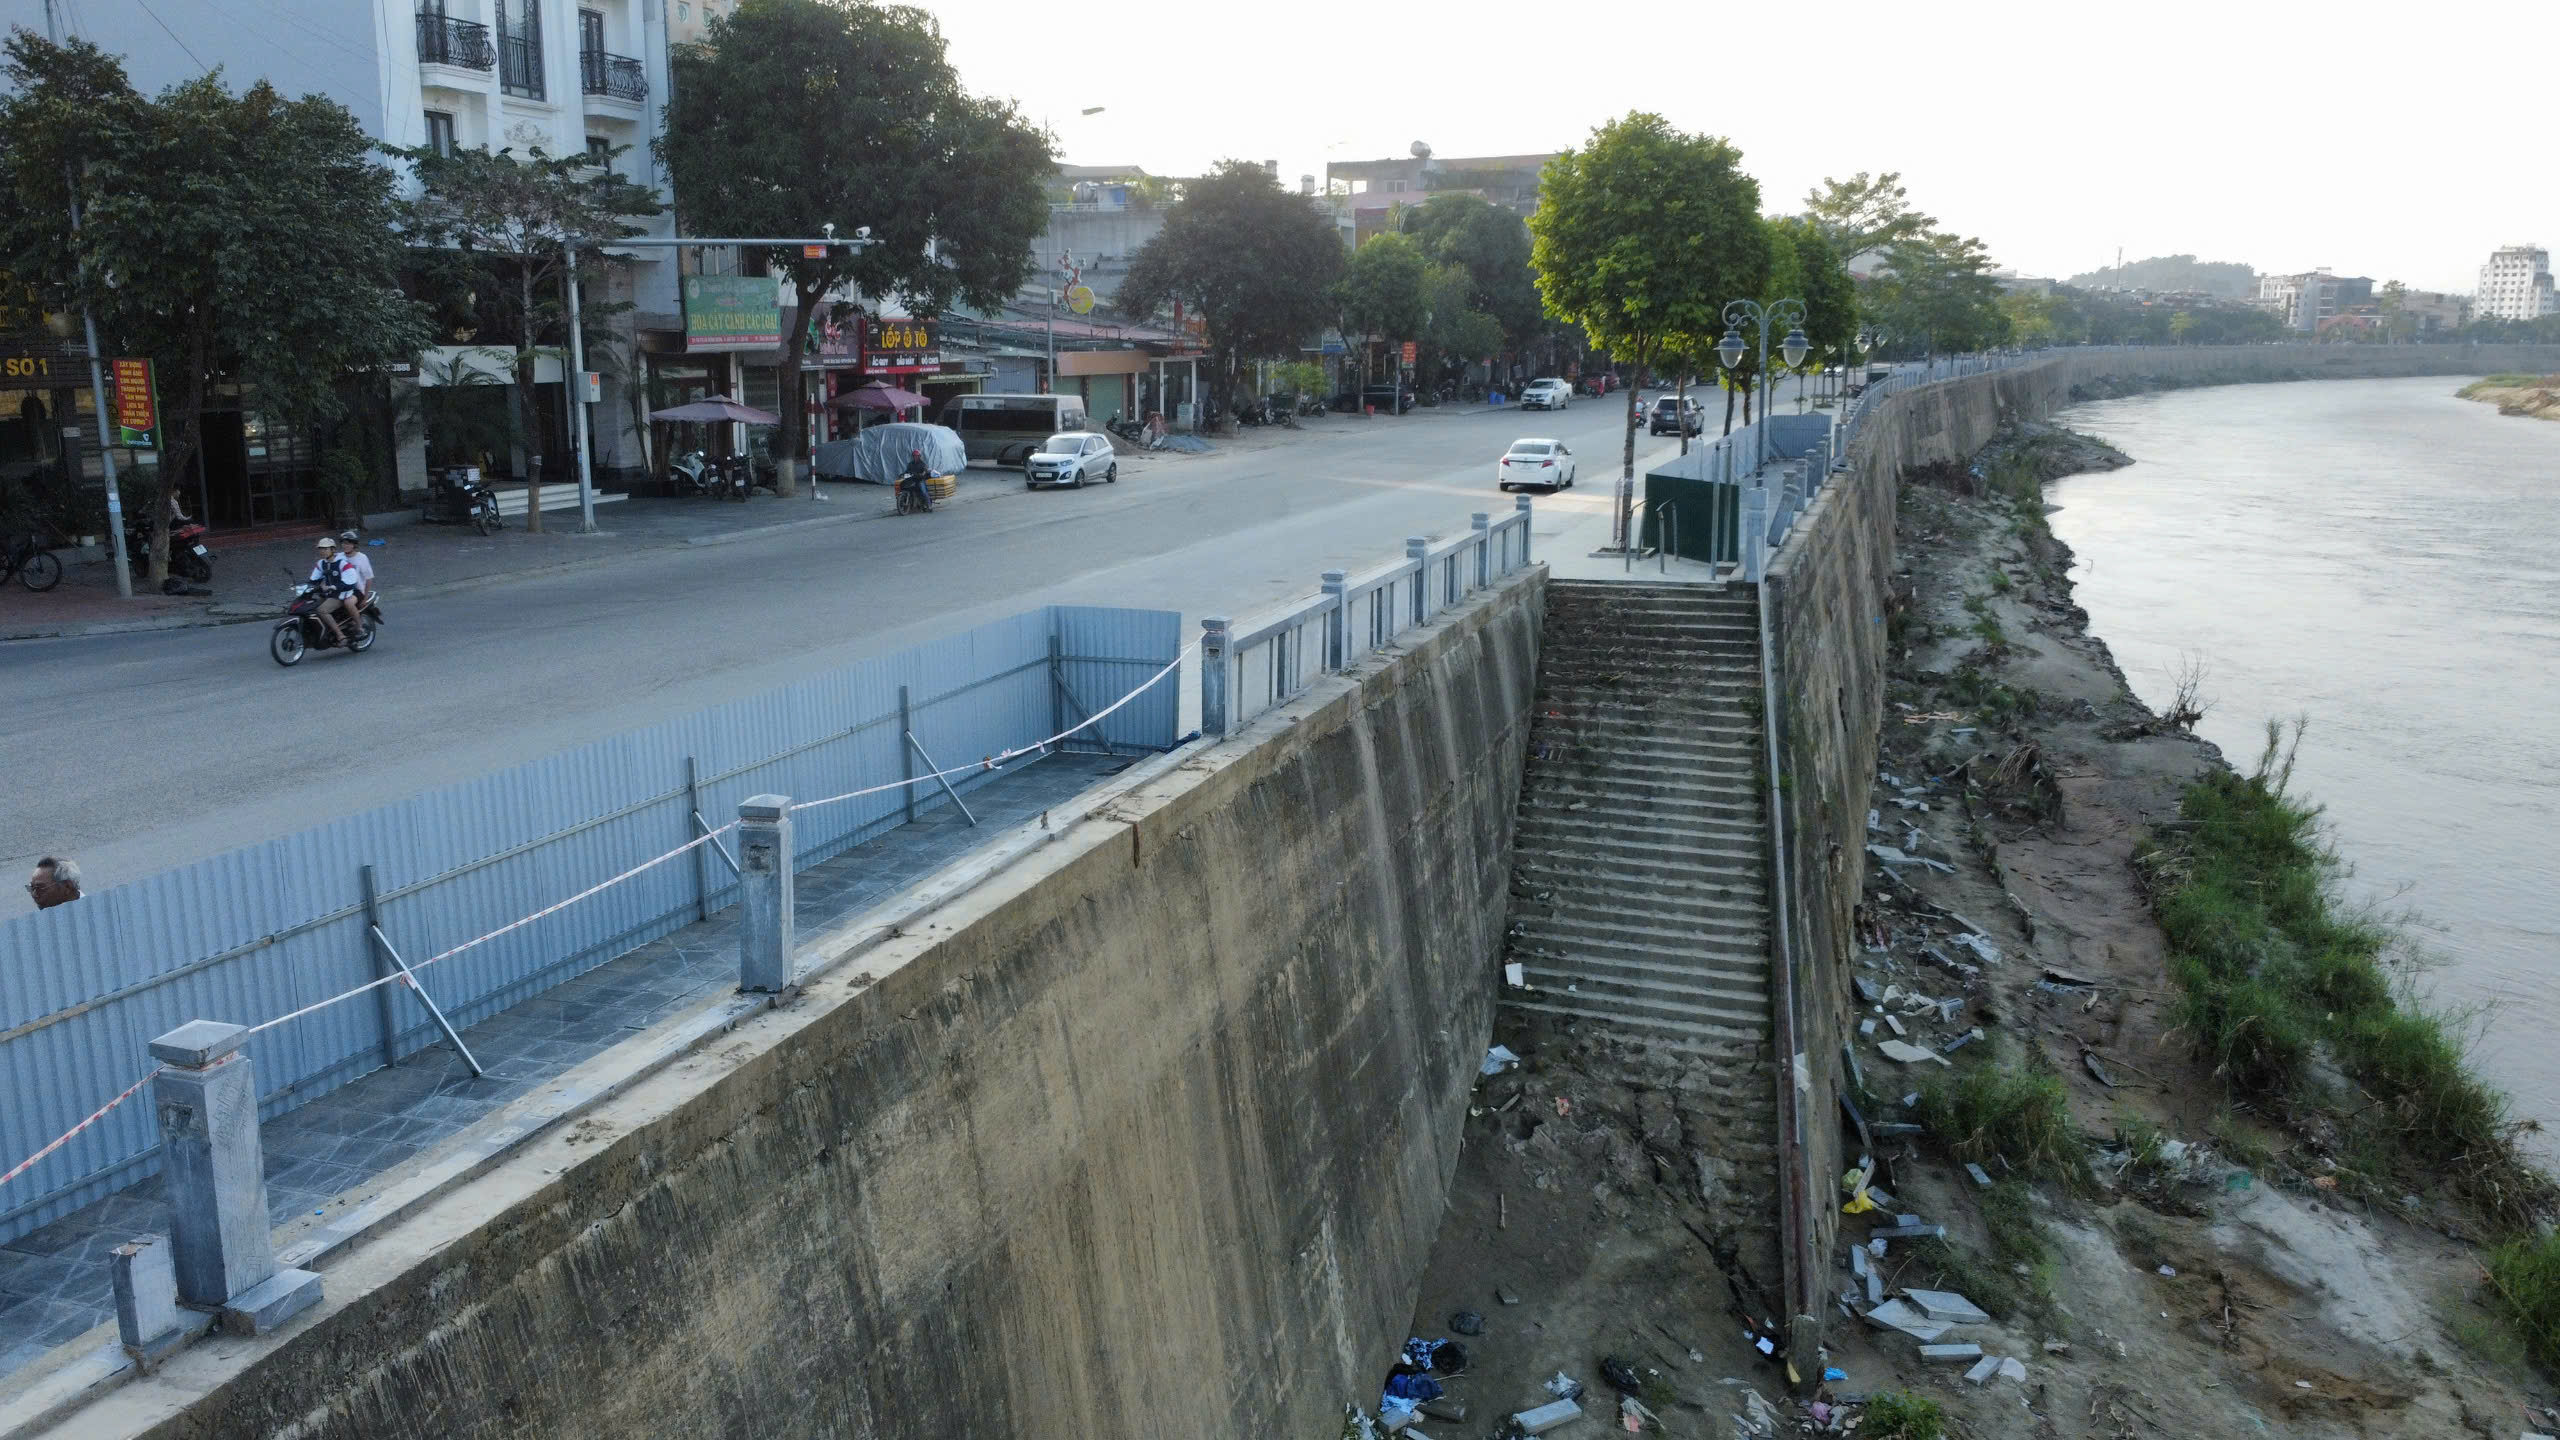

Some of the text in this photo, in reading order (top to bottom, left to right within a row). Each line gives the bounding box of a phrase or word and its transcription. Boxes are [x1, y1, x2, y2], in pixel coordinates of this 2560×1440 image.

[881, 323, 928, 348] LỐP Ô TÔ
[38, 358, 48, 376] 1
